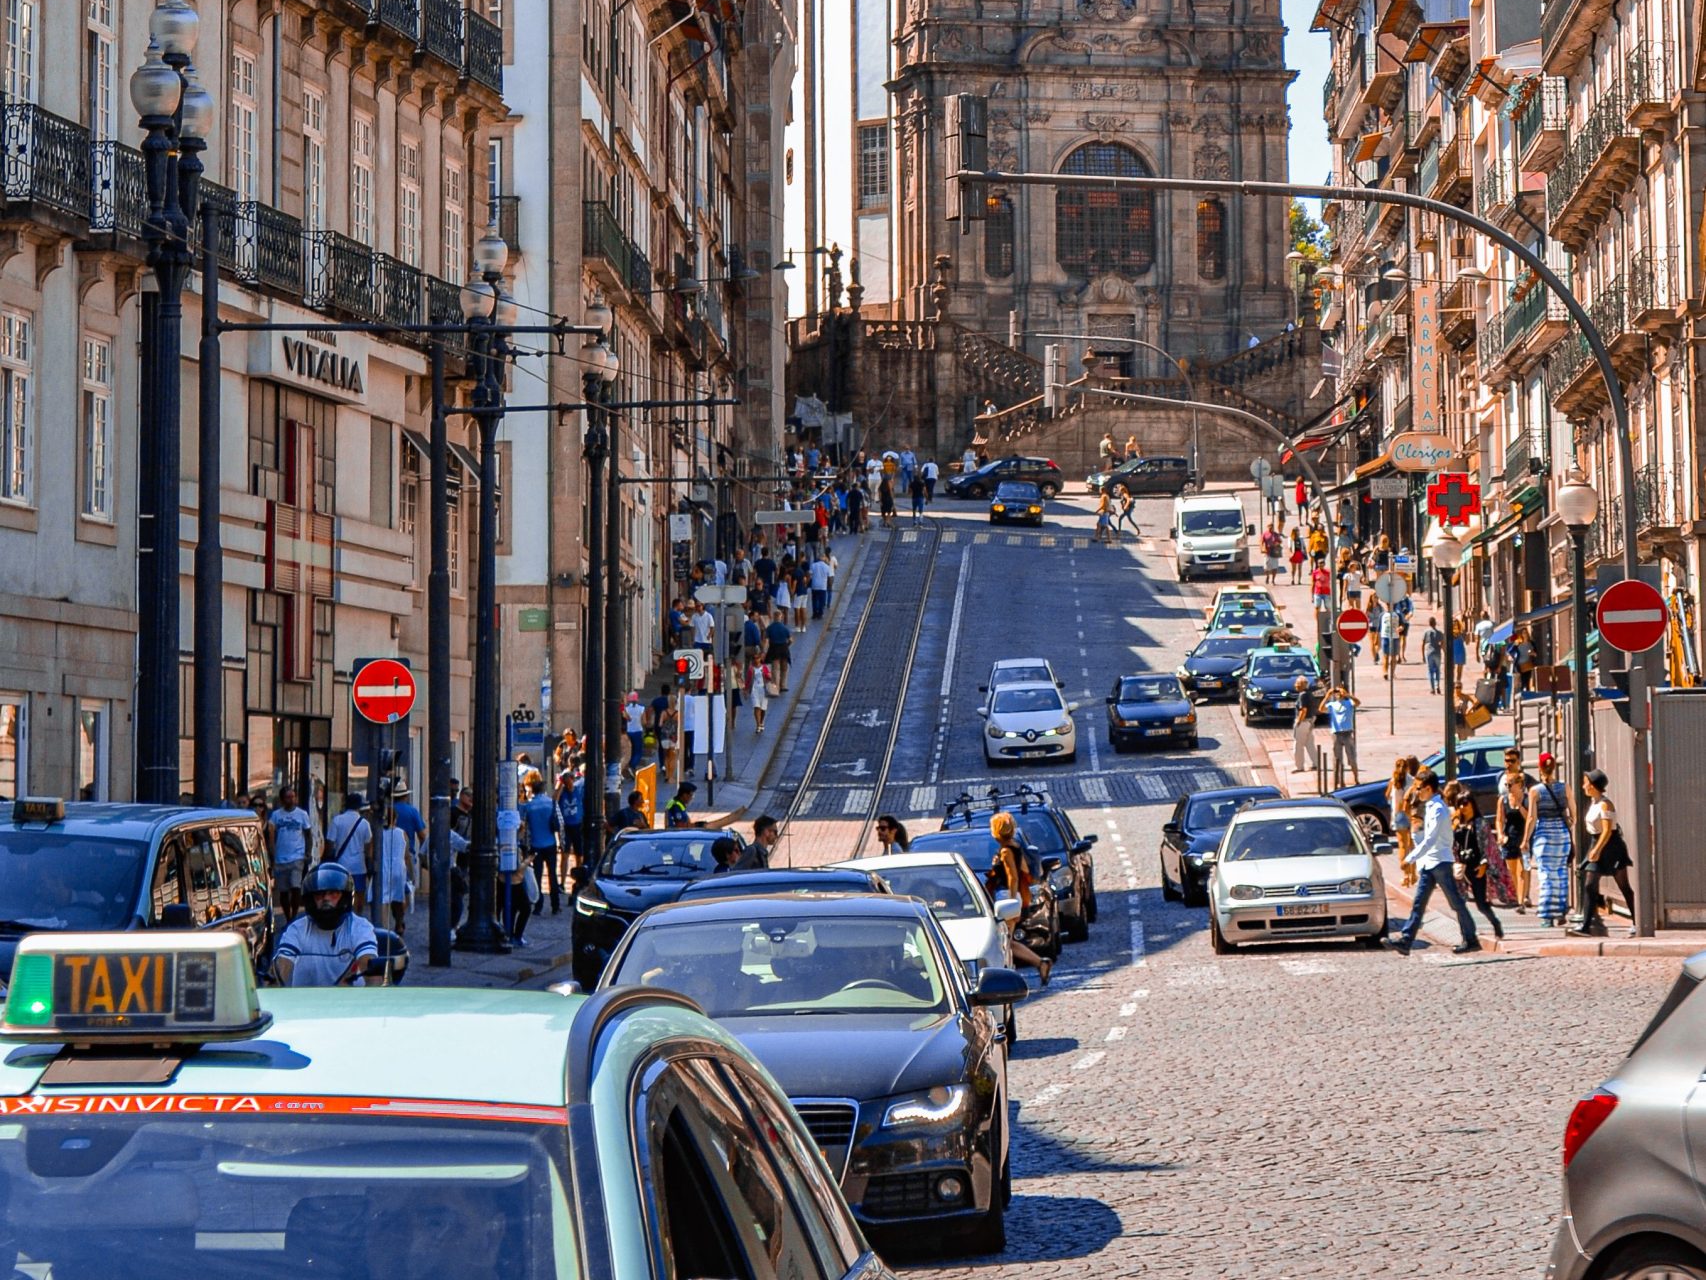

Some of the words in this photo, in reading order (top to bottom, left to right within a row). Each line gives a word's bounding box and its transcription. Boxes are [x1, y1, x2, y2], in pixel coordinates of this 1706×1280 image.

[282, 335, 364, 393] VITALIA
[1420, 296, 1434, 421] FARMACIA
[64, 955, 165, 1013] TAXI
